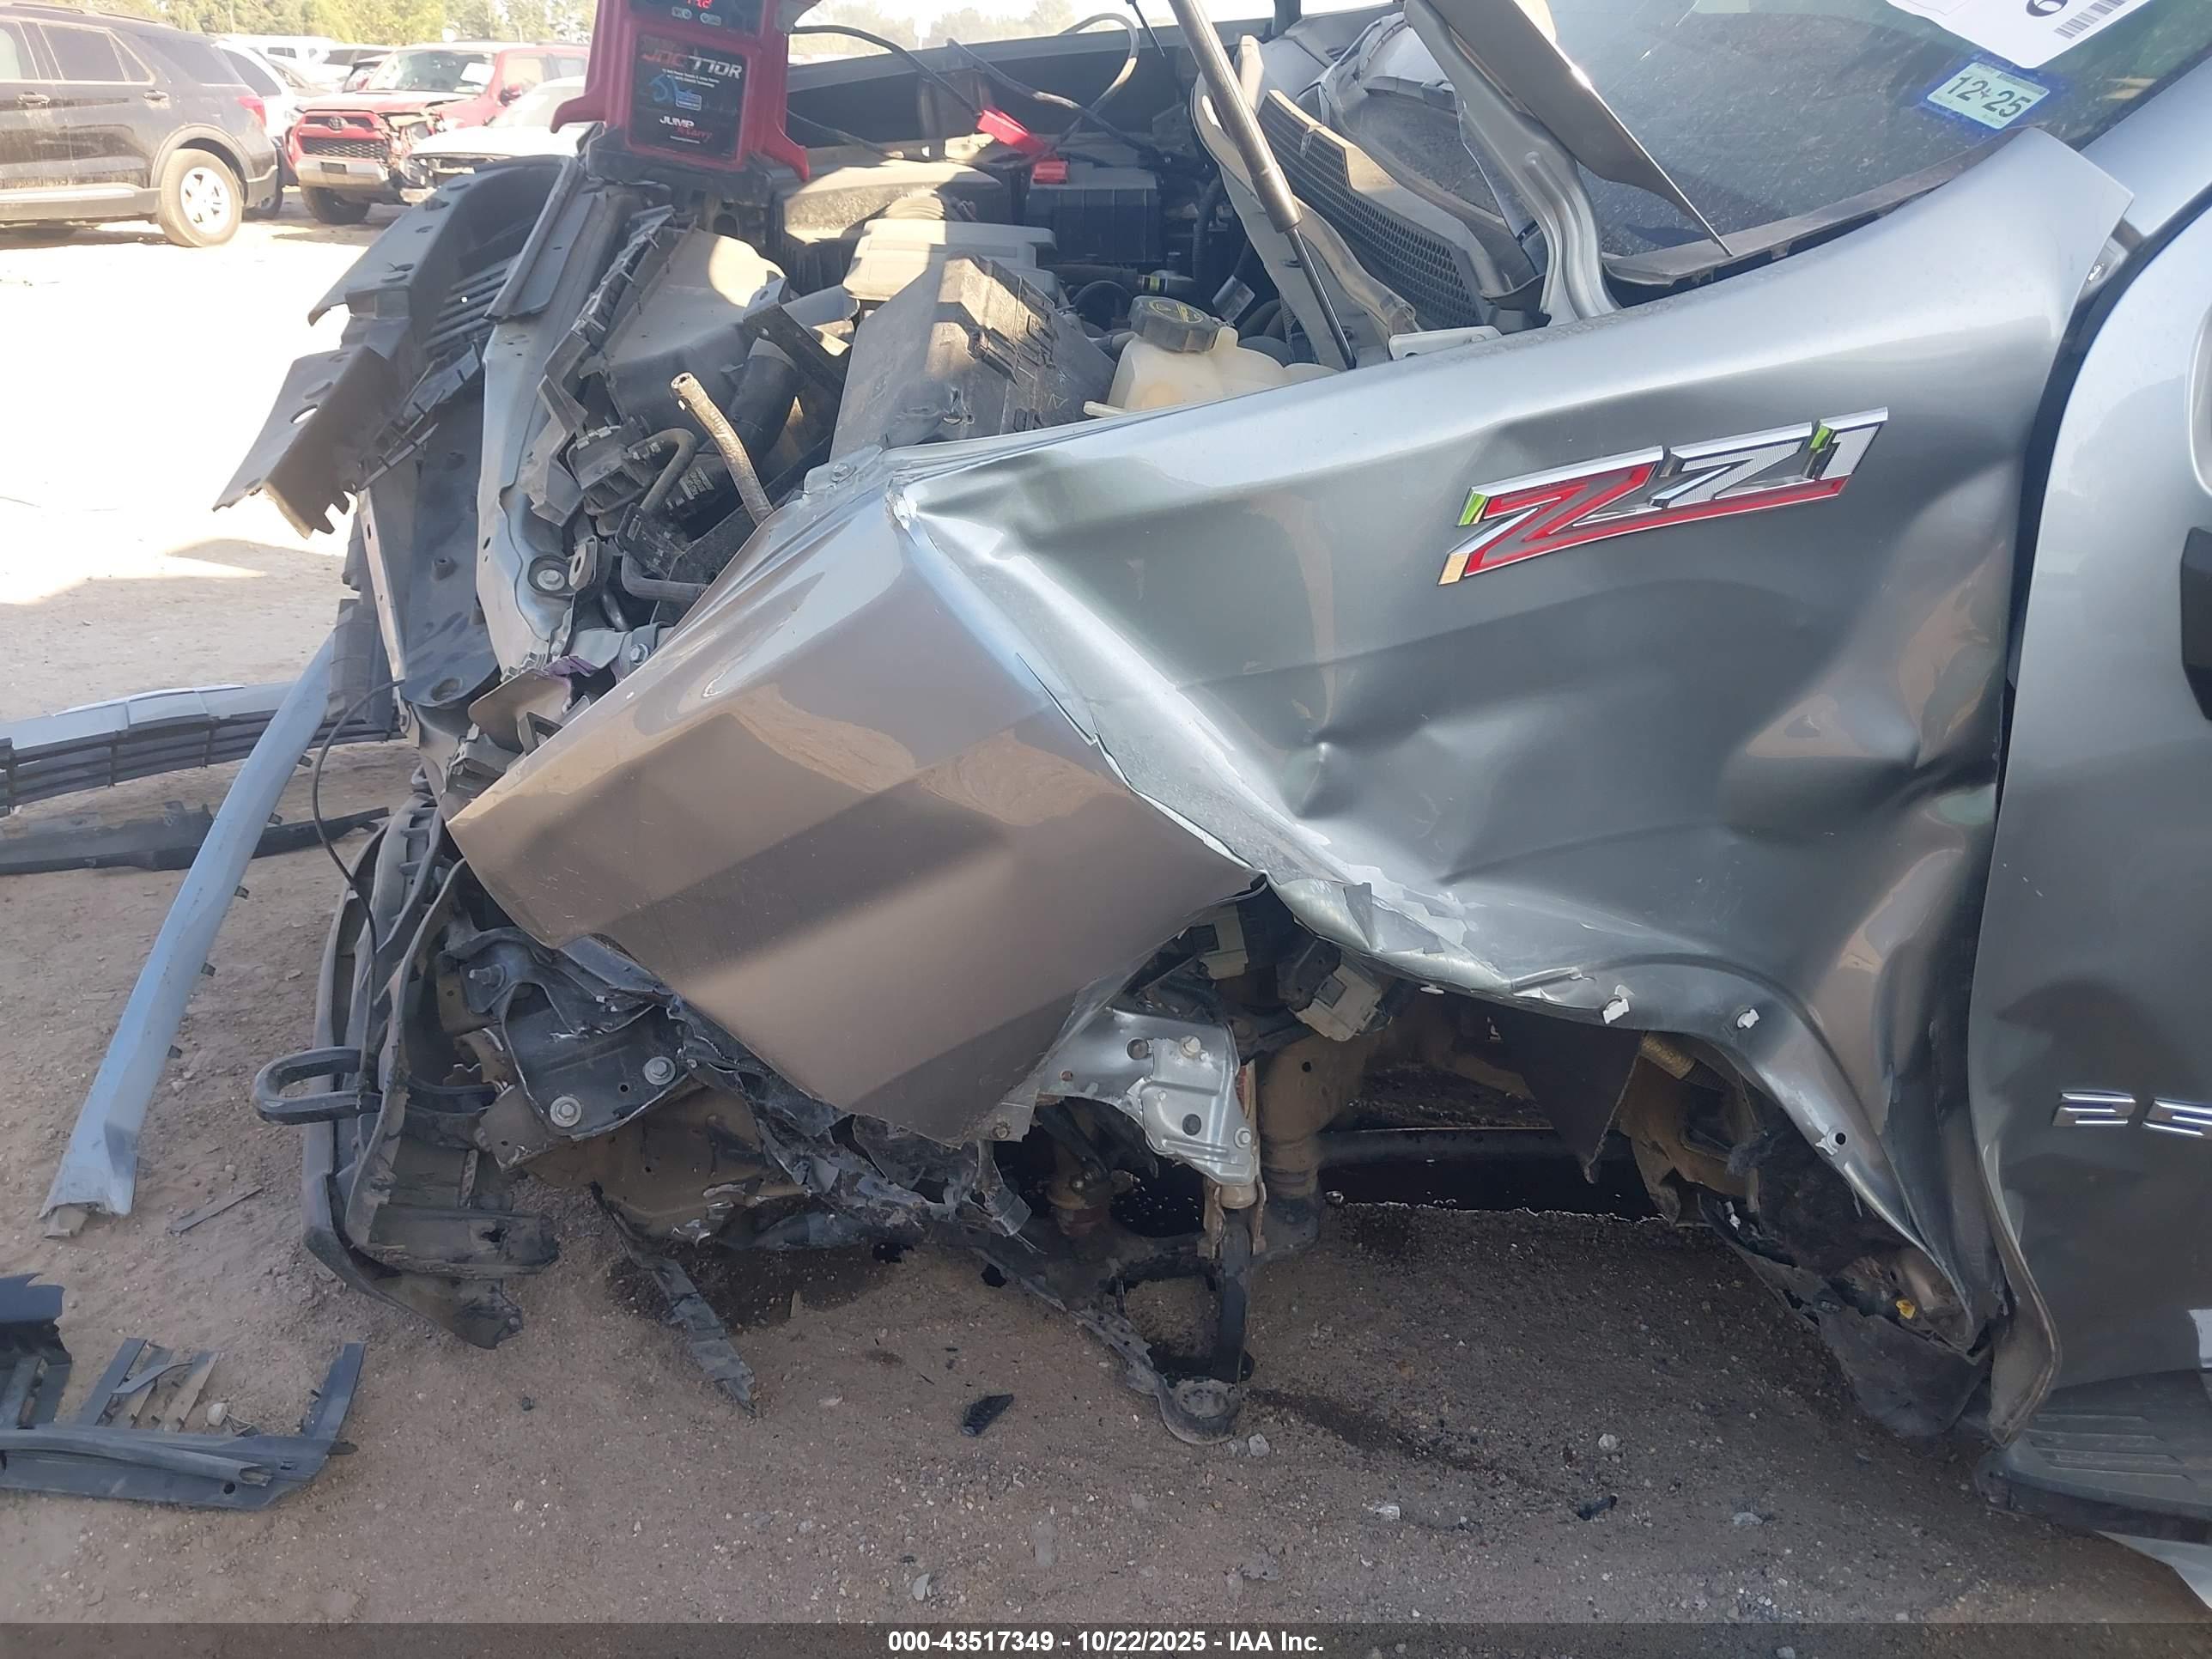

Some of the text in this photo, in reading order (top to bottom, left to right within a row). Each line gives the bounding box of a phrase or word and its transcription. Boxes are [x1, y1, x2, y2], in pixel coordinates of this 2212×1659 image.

[1982, 89, 2033, 118] 25
[659, 115, 695, 129] JUMP
[1437, 405, 1889, 586] Z71
